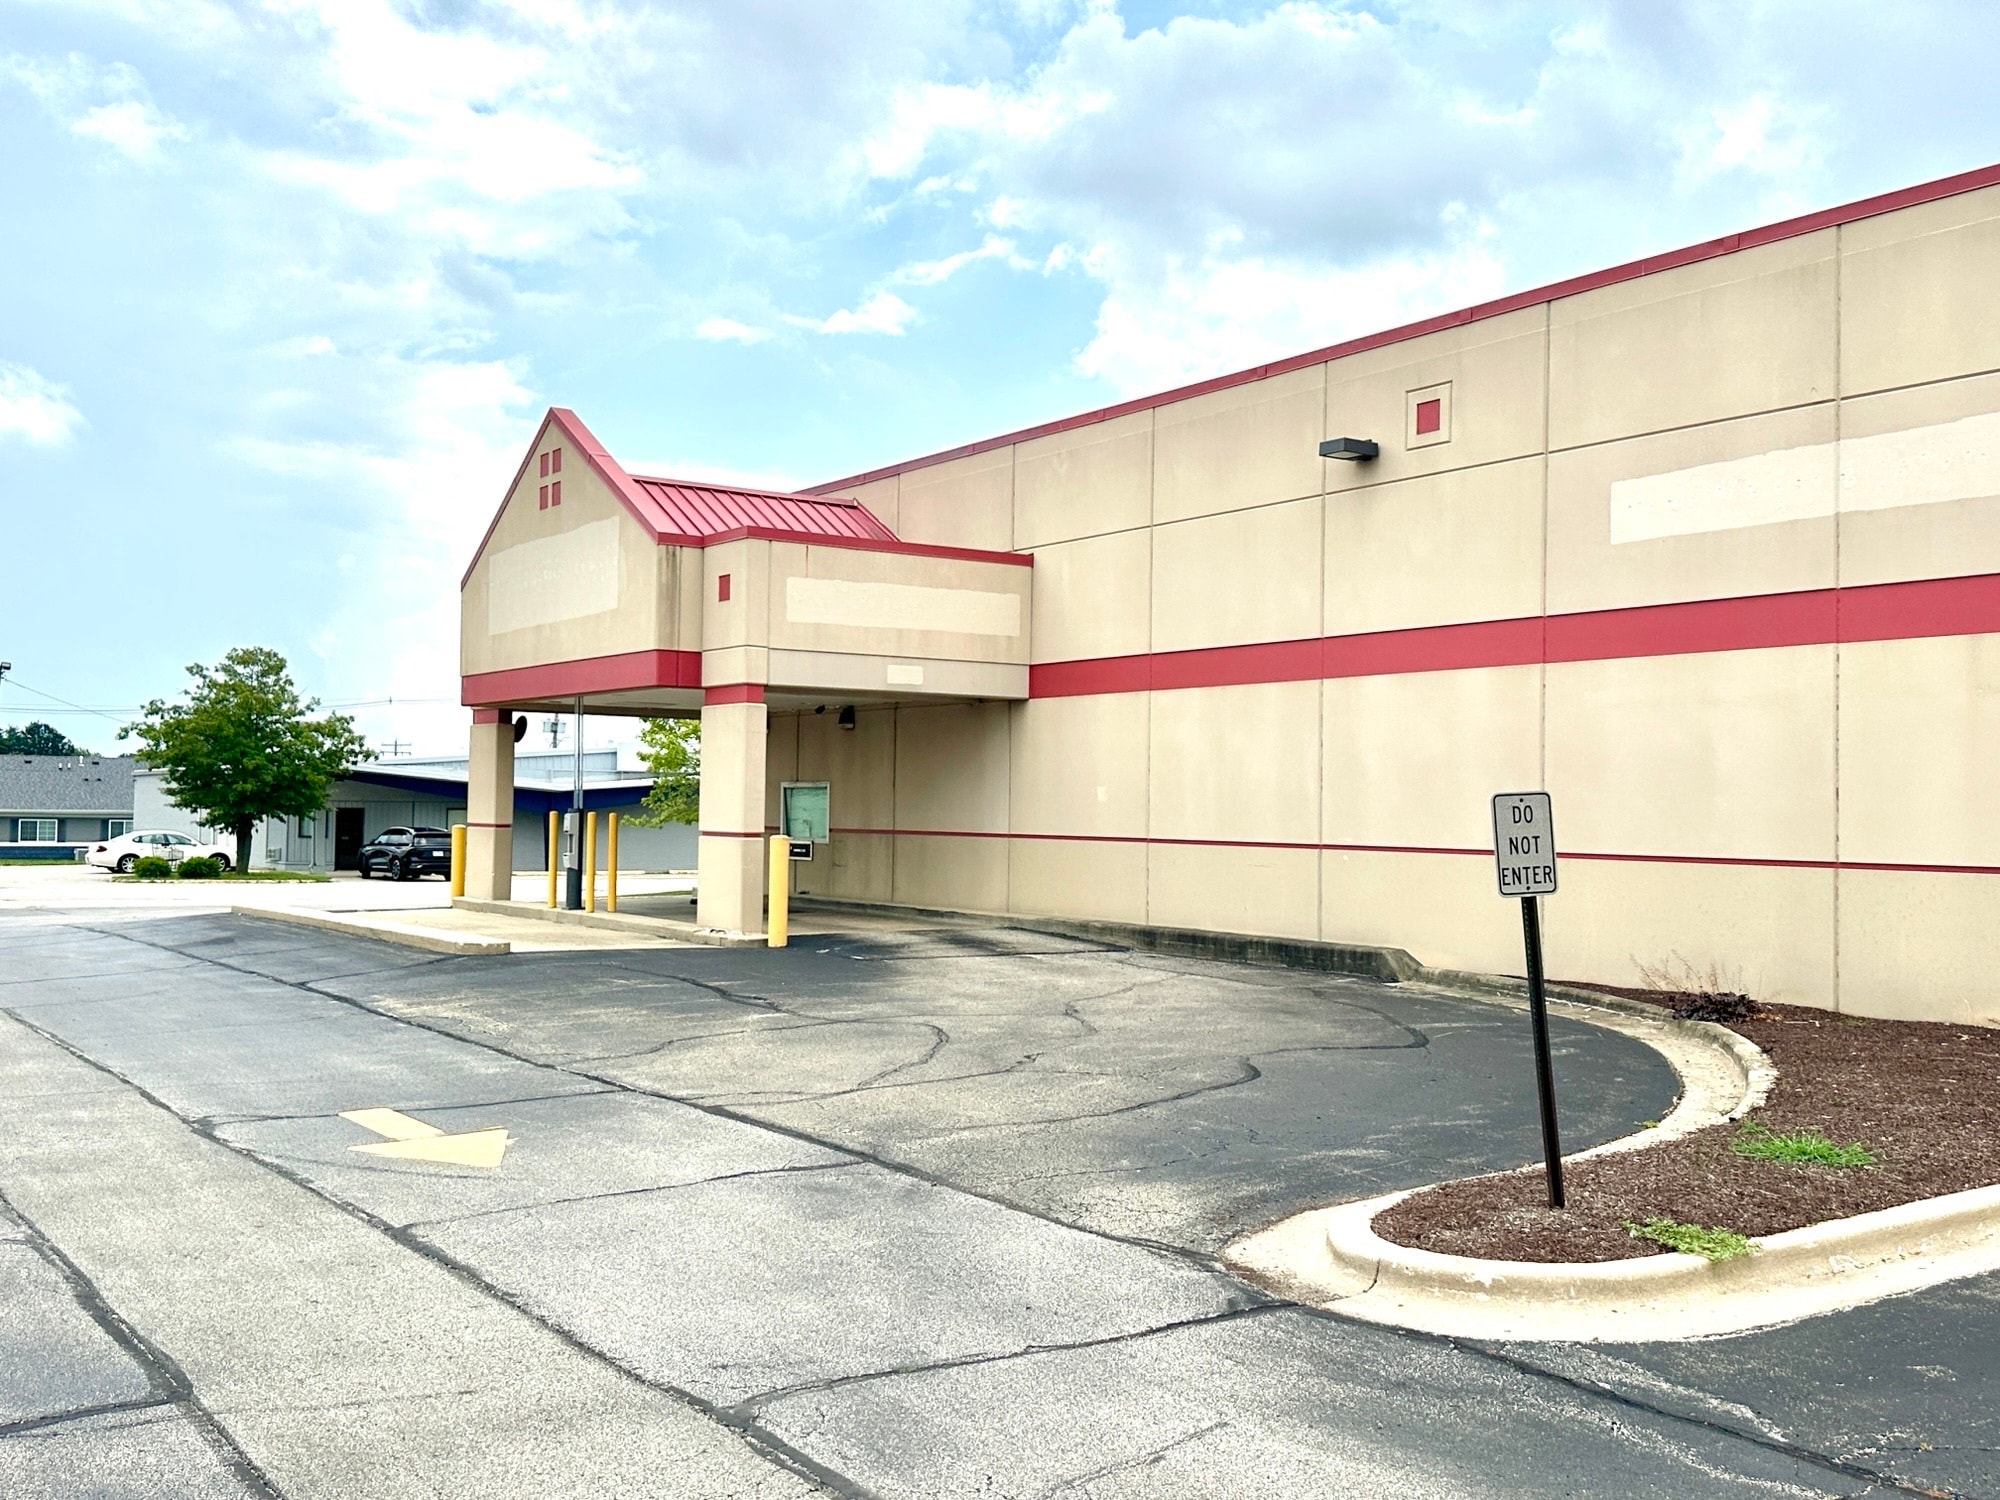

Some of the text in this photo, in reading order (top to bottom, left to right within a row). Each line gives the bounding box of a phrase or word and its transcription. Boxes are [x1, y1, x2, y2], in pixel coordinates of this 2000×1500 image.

[1512, 805, 1533, 823] DO
[1509, 836, 1540, 855] NOT
[1502, 866, 1553, 886] ENTER
